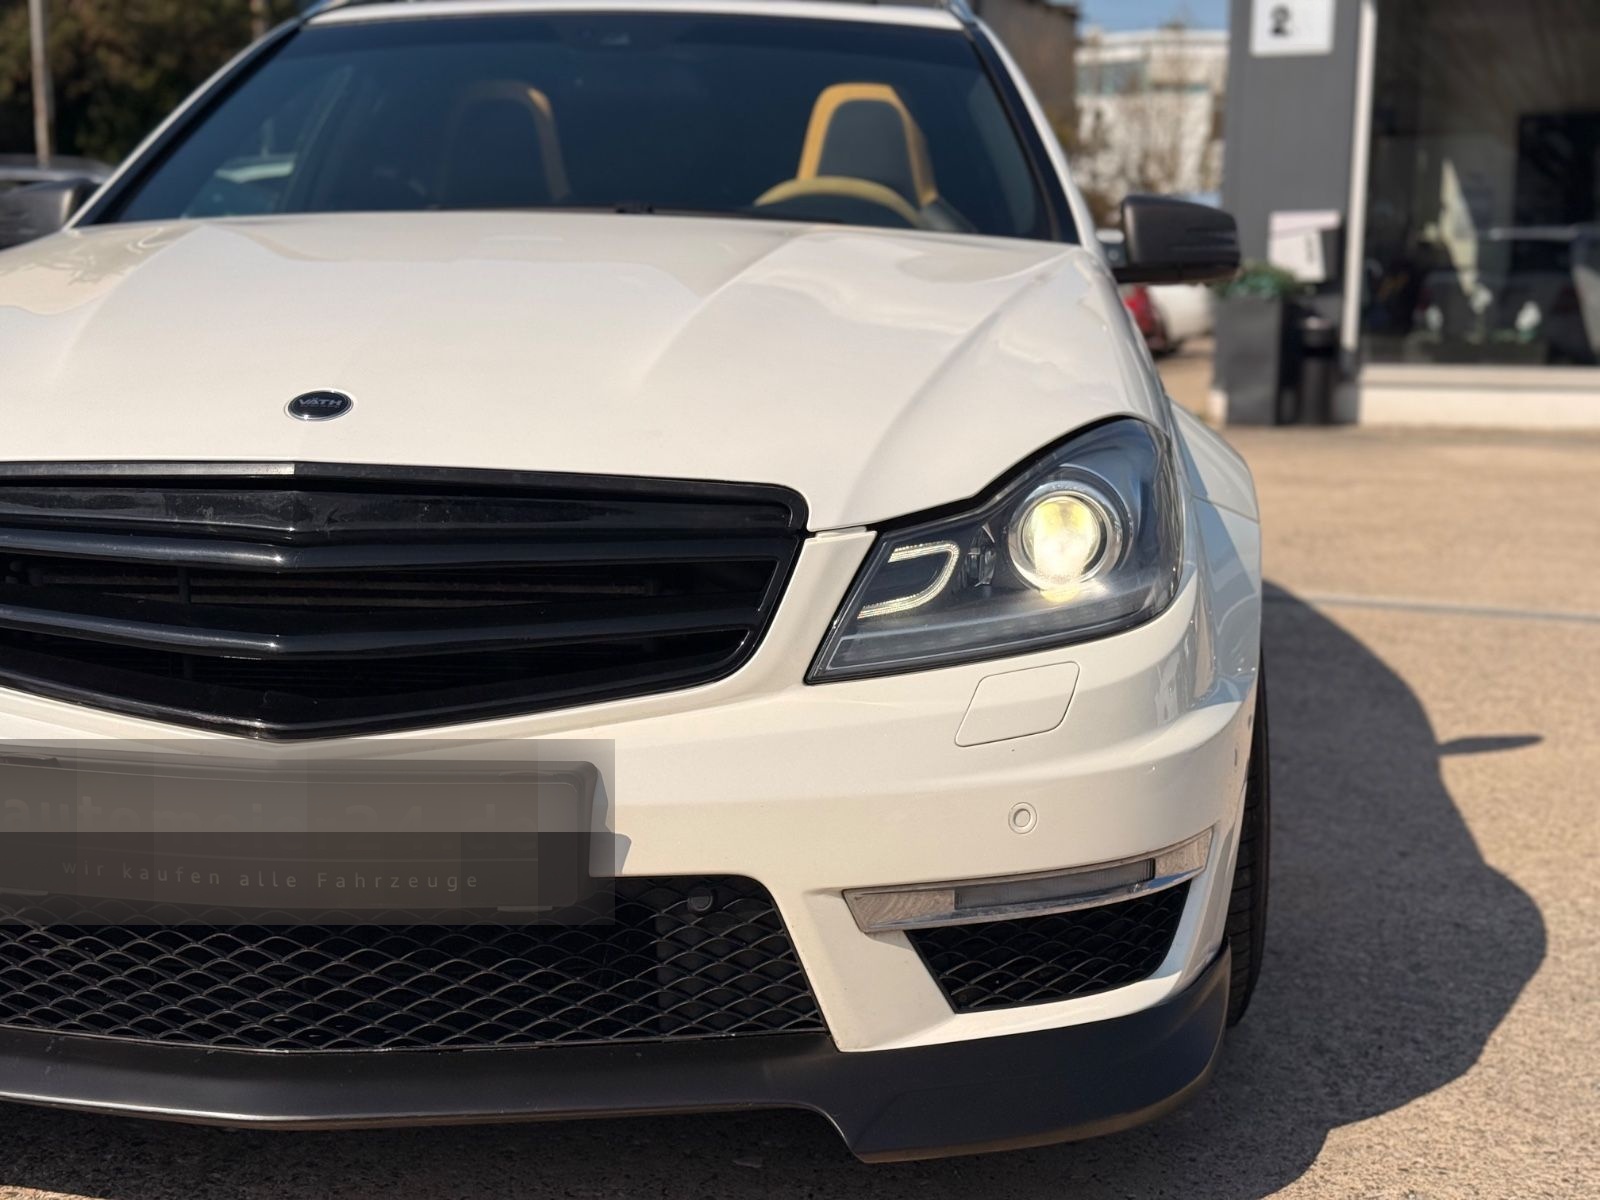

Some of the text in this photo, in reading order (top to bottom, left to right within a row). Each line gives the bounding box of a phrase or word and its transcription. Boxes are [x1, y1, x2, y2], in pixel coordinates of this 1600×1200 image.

[62, 861, 478, 892] wir kaufen alle Fahrzeuge
